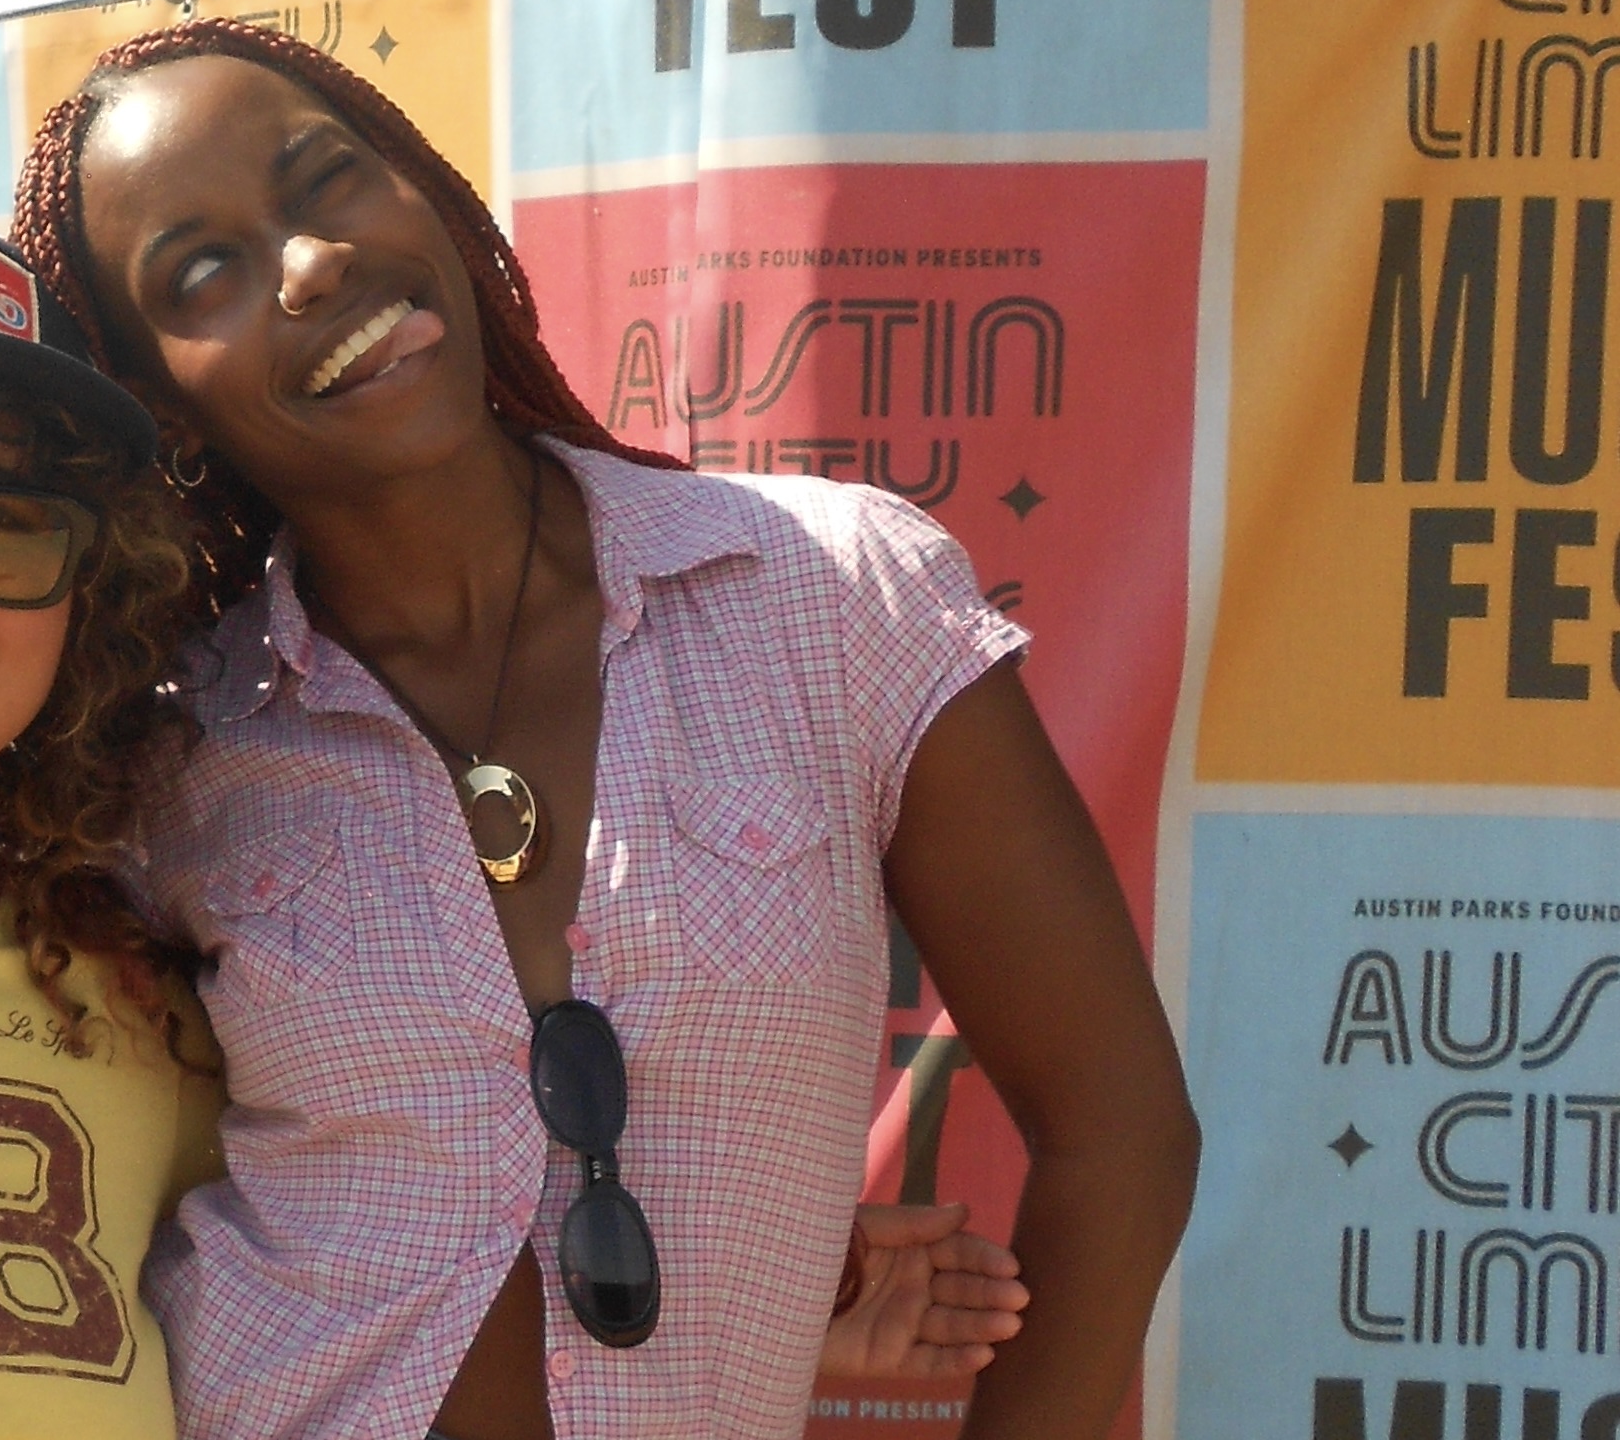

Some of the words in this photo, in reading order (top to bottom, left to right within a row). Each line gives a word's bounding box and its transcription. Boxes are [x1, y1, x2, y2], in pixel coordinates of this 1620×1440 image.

[628, 265, 689, 288] AUSTIN
[696, 249, 752, 271] ARKS
[759, 248, 908, 268] FOUNDATION
[917, 248, 1043, 268] PRESENTS
[607, 295, 1066, 431] AUSTIN
[1402, 507, 1620, 702] FE
[1353, 898, 1442, 918] AUSTIN
[1451, 899, 1531, 919] PARKS
[1339, 1226, 1620, 1355] LIM
[859, 1398, 966, 1419] PRESENT
